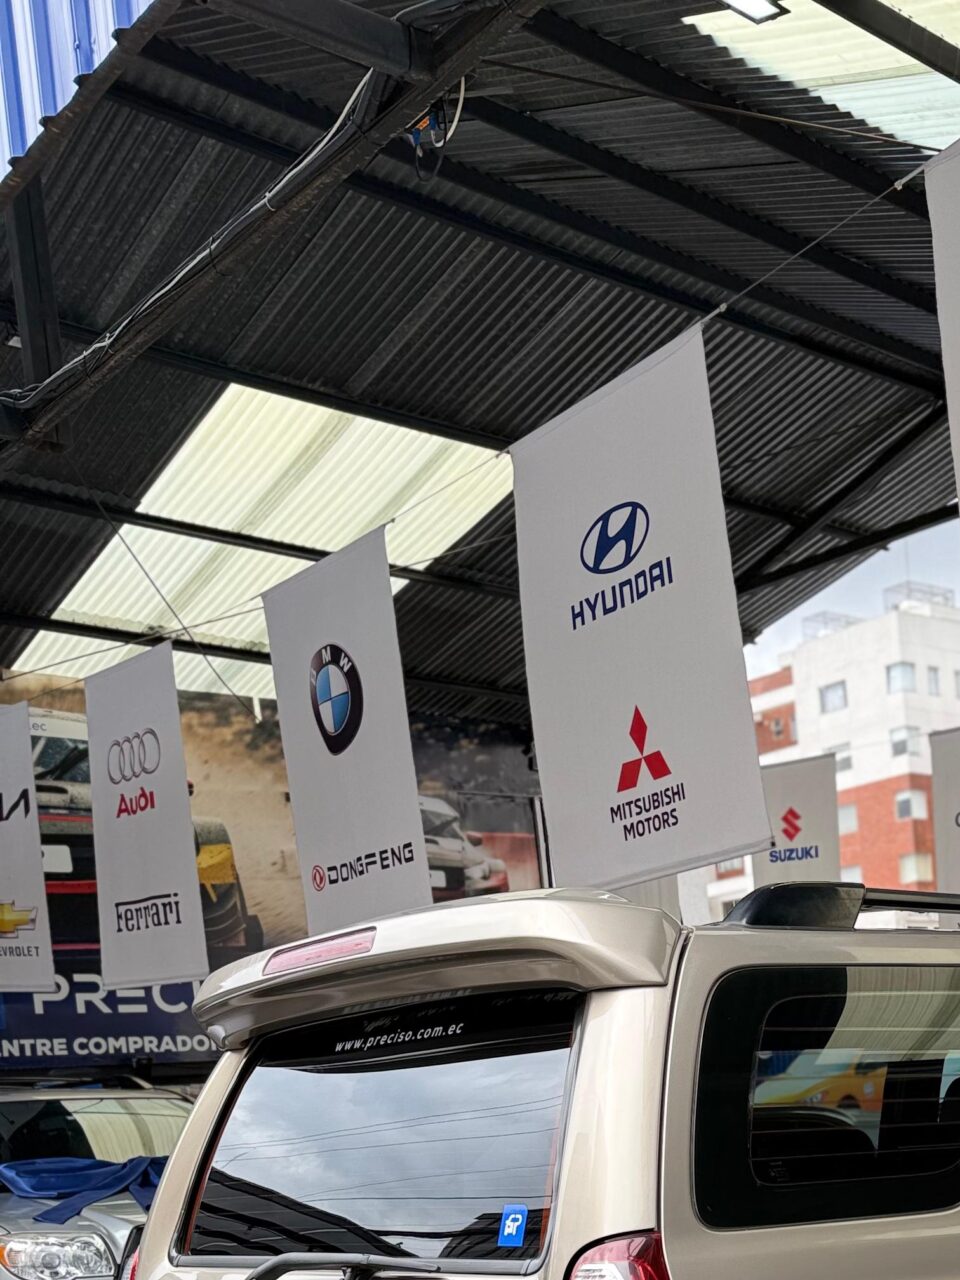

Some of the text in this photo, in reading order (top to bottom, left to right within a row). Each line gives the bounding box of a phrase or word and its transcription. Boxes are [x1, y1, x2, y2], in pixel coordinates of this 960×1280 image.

[570, 556, 674, 631] HYUNDAI
[116, 786, 156, 819] Audi
[610, 782, 686, 824] MITSUBISHI
[623, 808, 679, 842] MOTORS
[327, 841, 415, 885] DONGFENG
[769, 845, 819, 864] SUZUKI
[115, 892, 182, 933] Ferrari
[0, 1038, 69, 1057] NTRE
[334, 1021, 465, 1052] www.preciso.com.ec
